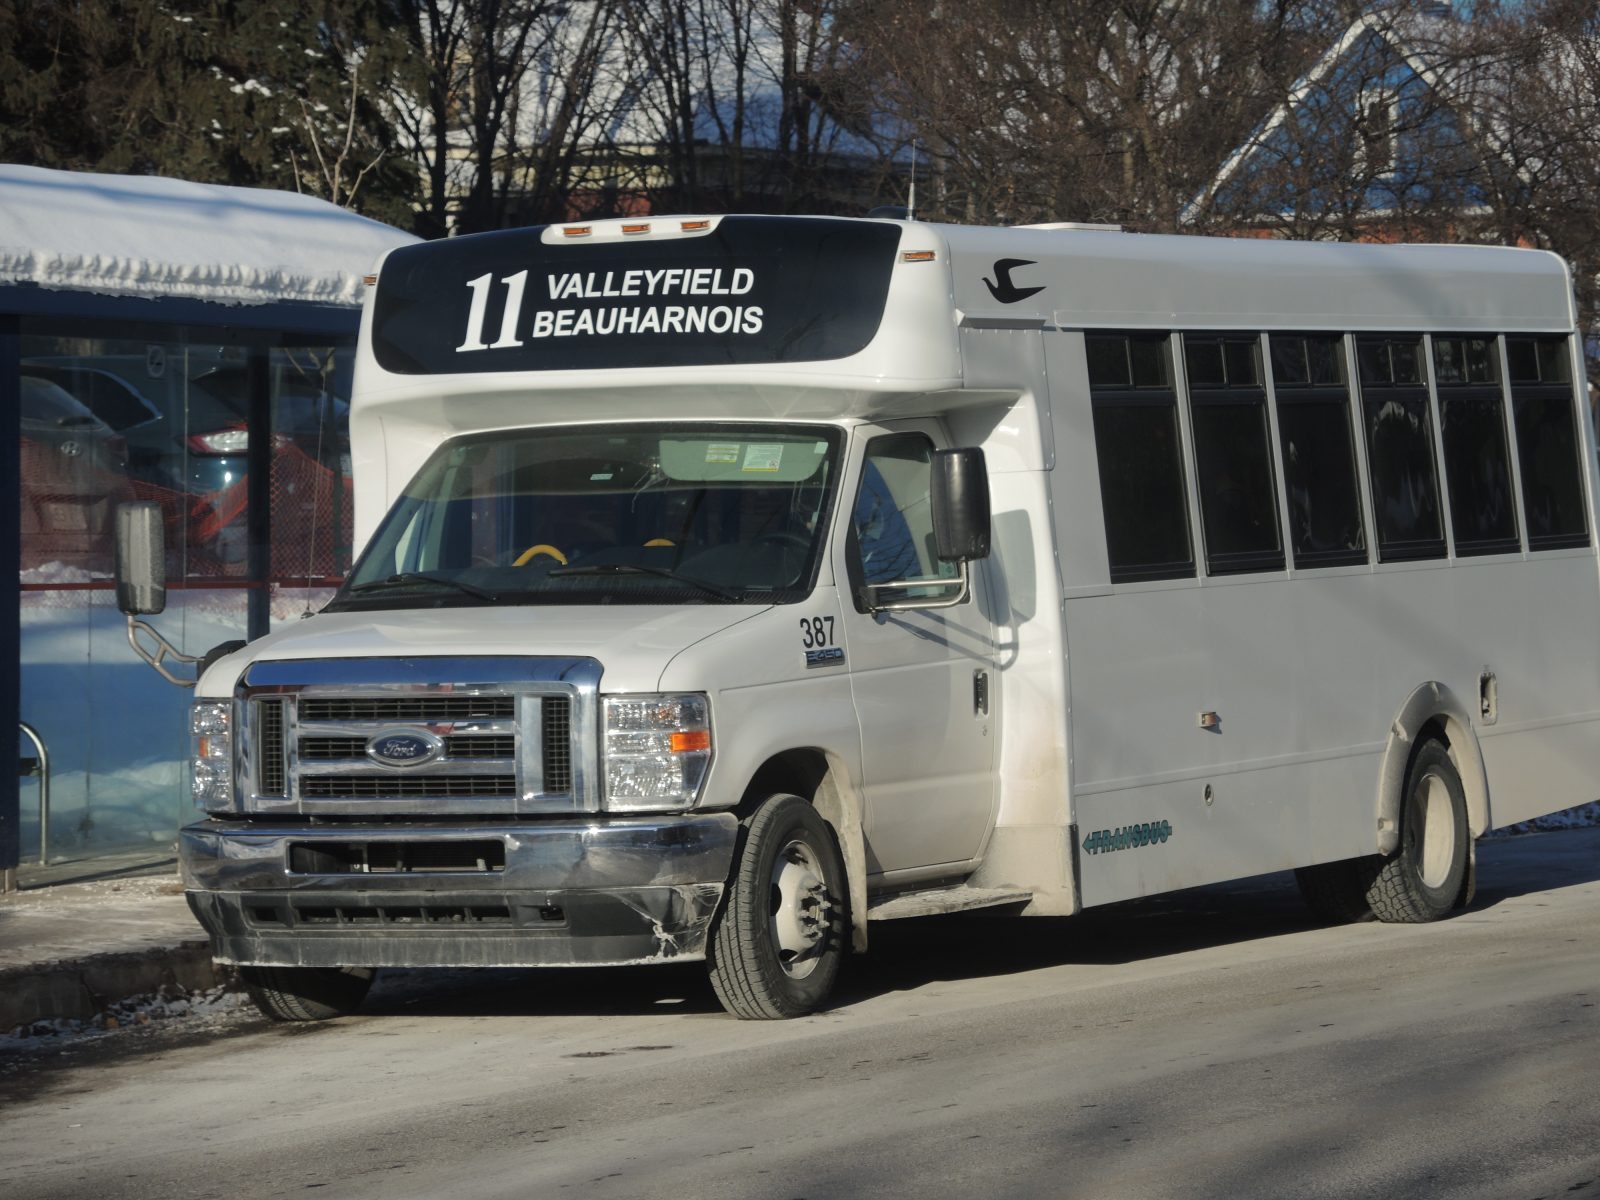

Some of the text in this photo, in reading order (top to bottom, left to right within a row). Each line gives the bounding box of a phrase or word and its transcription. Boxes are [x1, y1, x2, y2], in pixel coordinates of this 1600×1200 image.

[548, 268, 755, 300] VALLEYFIELD
[456, 269, 529, 352] 11
[532, 306, 764, 338] BEAUHARNOIS
[800, 616, 835, 648] 387
[384, 739, 417, 755] Ford
[1091, 820, 1170, 855] TRANSBUS
